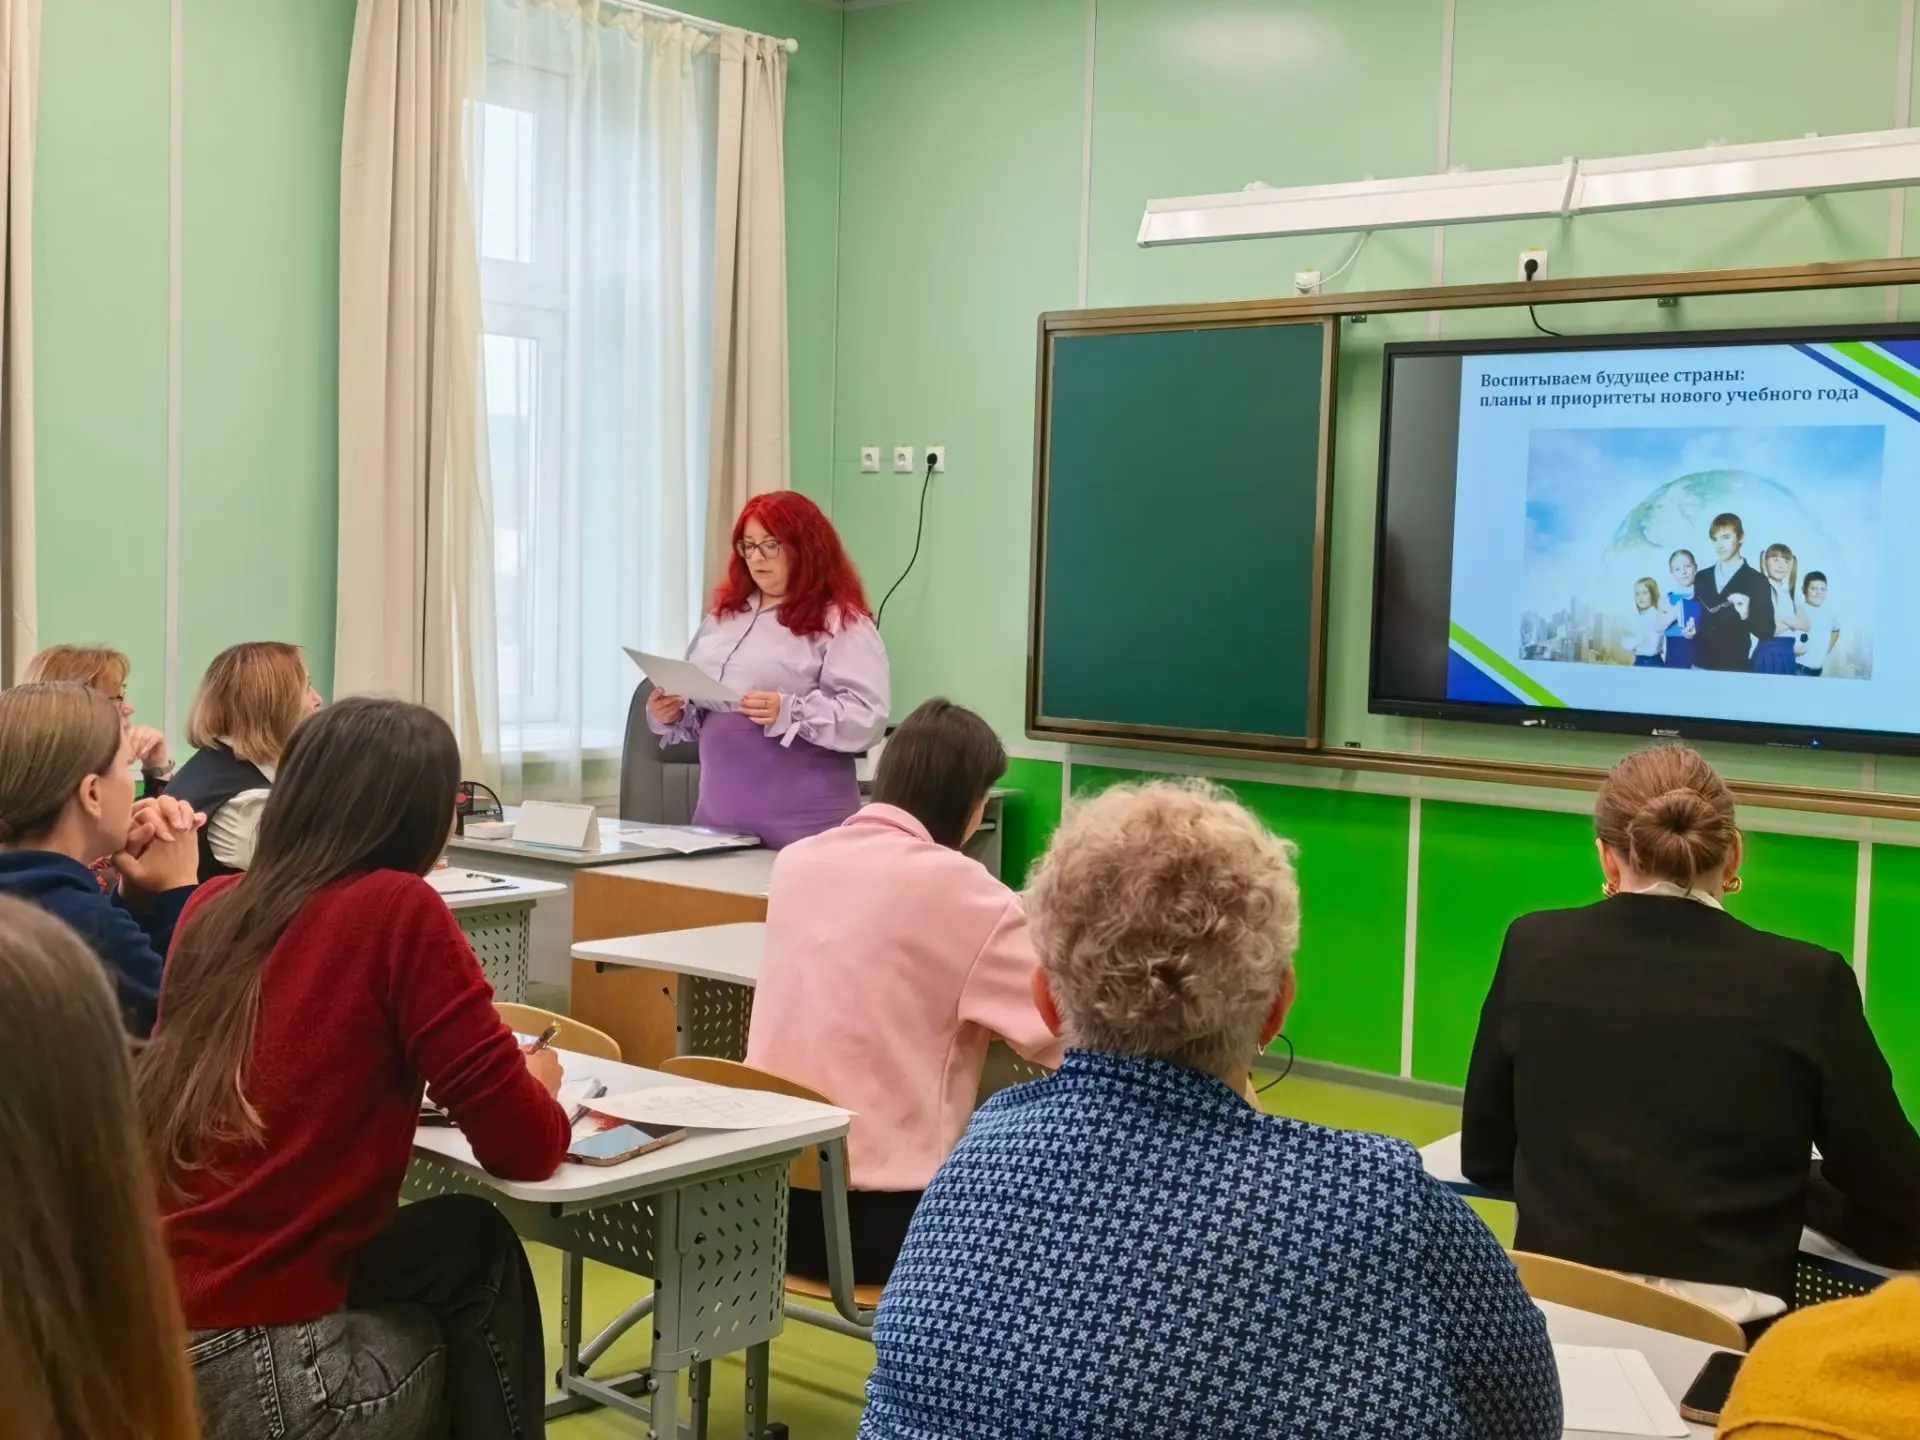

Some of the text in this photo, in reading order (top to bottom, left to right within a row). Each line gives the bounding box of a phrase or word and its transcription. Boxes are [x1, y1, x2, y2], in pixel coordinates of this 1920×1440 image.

[1481, 369, 1745, 388] Воспитываем будущее страны:
[1480, 387, 1859, 408] планы и приоритеты нового учебного года
